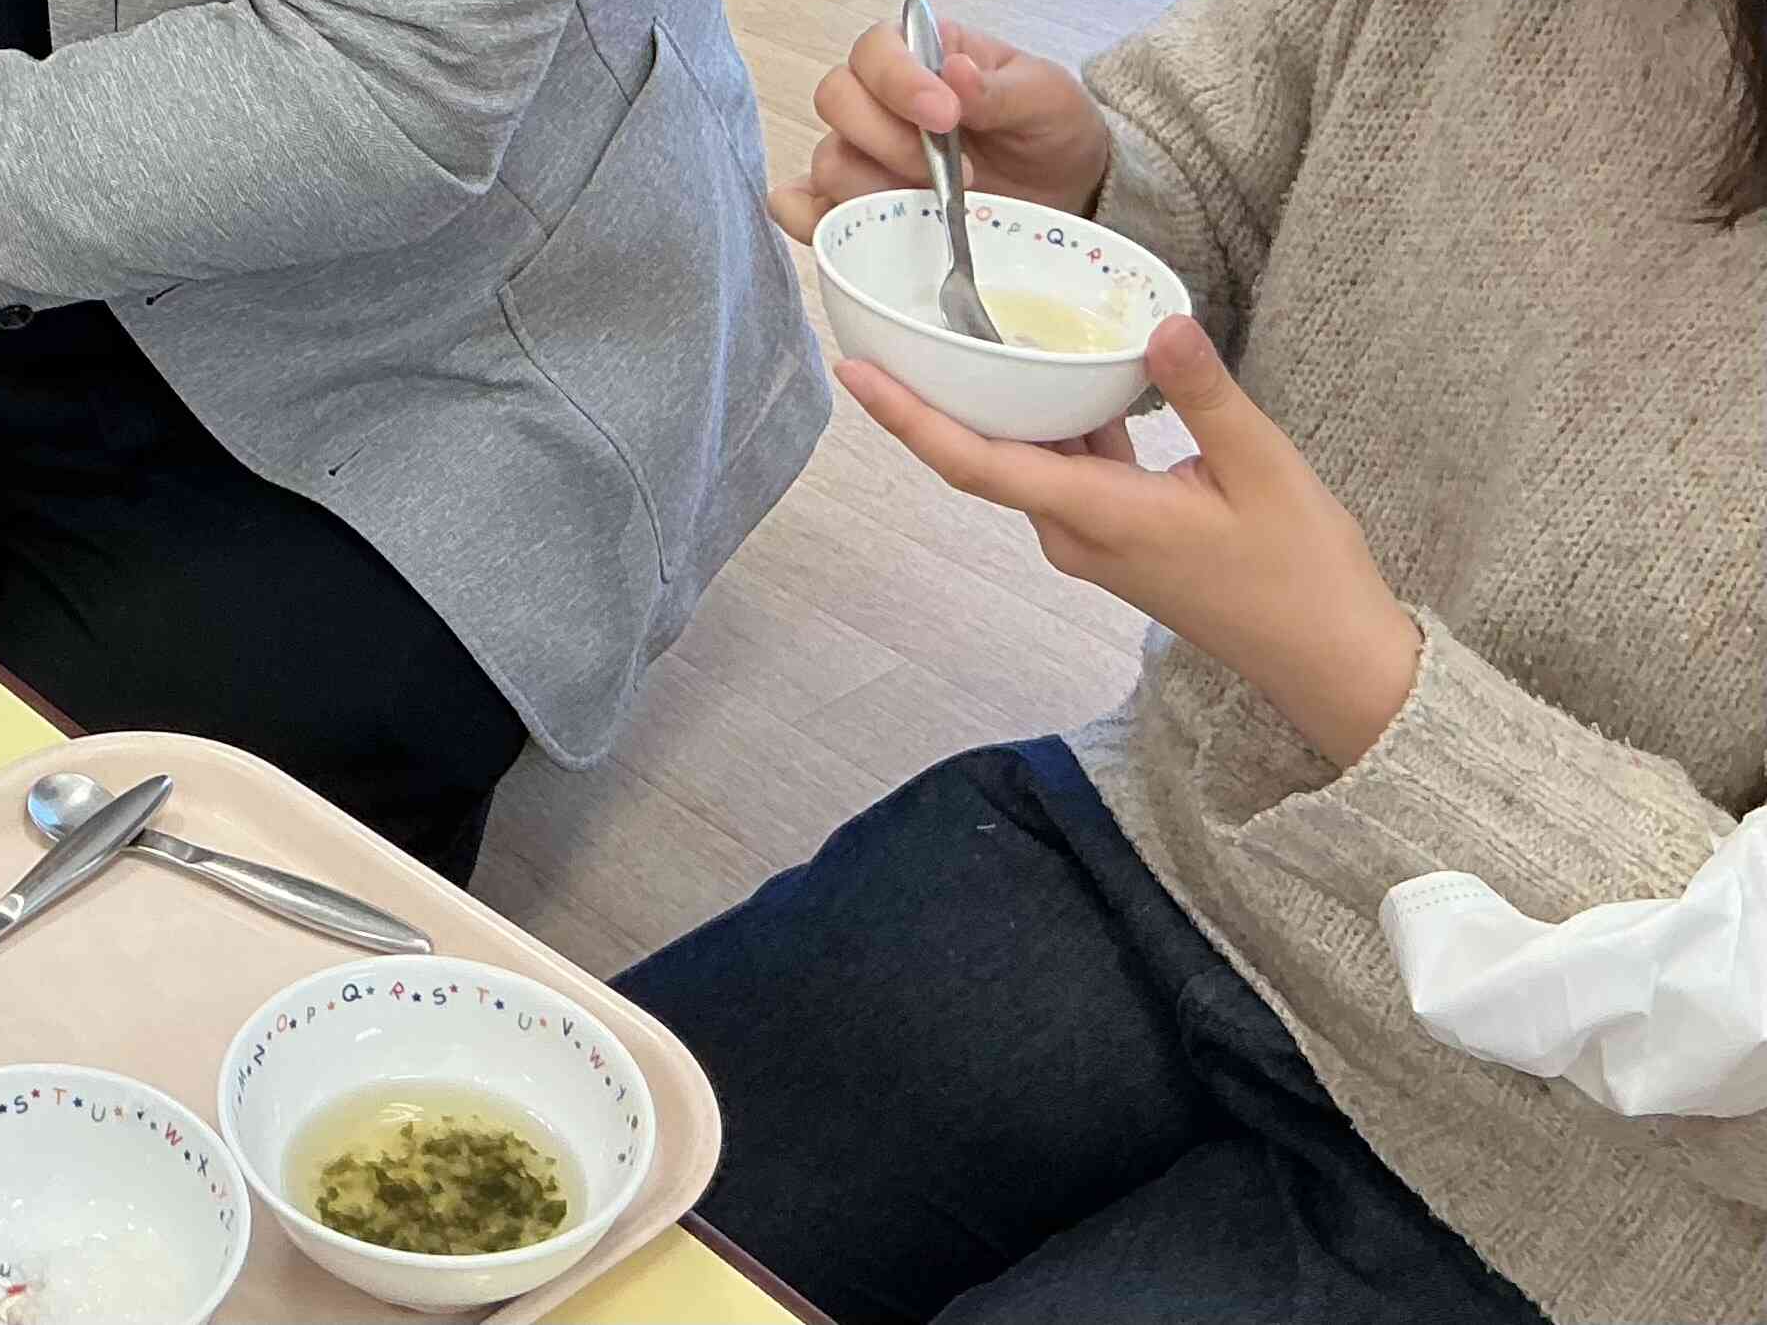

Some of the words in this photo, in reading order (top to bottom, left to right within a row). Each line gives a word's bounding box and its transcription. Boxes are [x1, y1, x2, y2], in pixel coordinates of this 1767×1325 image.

[892, 202, 906, 219] M
[976, 206, 992, 222] O
[1007, 222, 1021, 235] P
[1047, 228, 1065, 247] Q
[1086, 247, 1102, 264] R
[276, 1014, 288, 1033] O
[307, 1006, 316, 1024] P
[342, 984, 362, 1002] Q
[390, 981, 405, 1000] R
[432, 988, 447, 1005] S
[477, 987, 490, 1004] T
[518, 1012, 532, 1031] U
[563, 1017, 573, 1036] V
[590, 1046, 605, 1069] W
[13, 1095, 28, 1114] S
[53, 1088, 67, 1105] T
[91, 1105, 106, 1123] U
[165, 1122, 183, 1146] W
[197, 1153, 209, 1177] X
